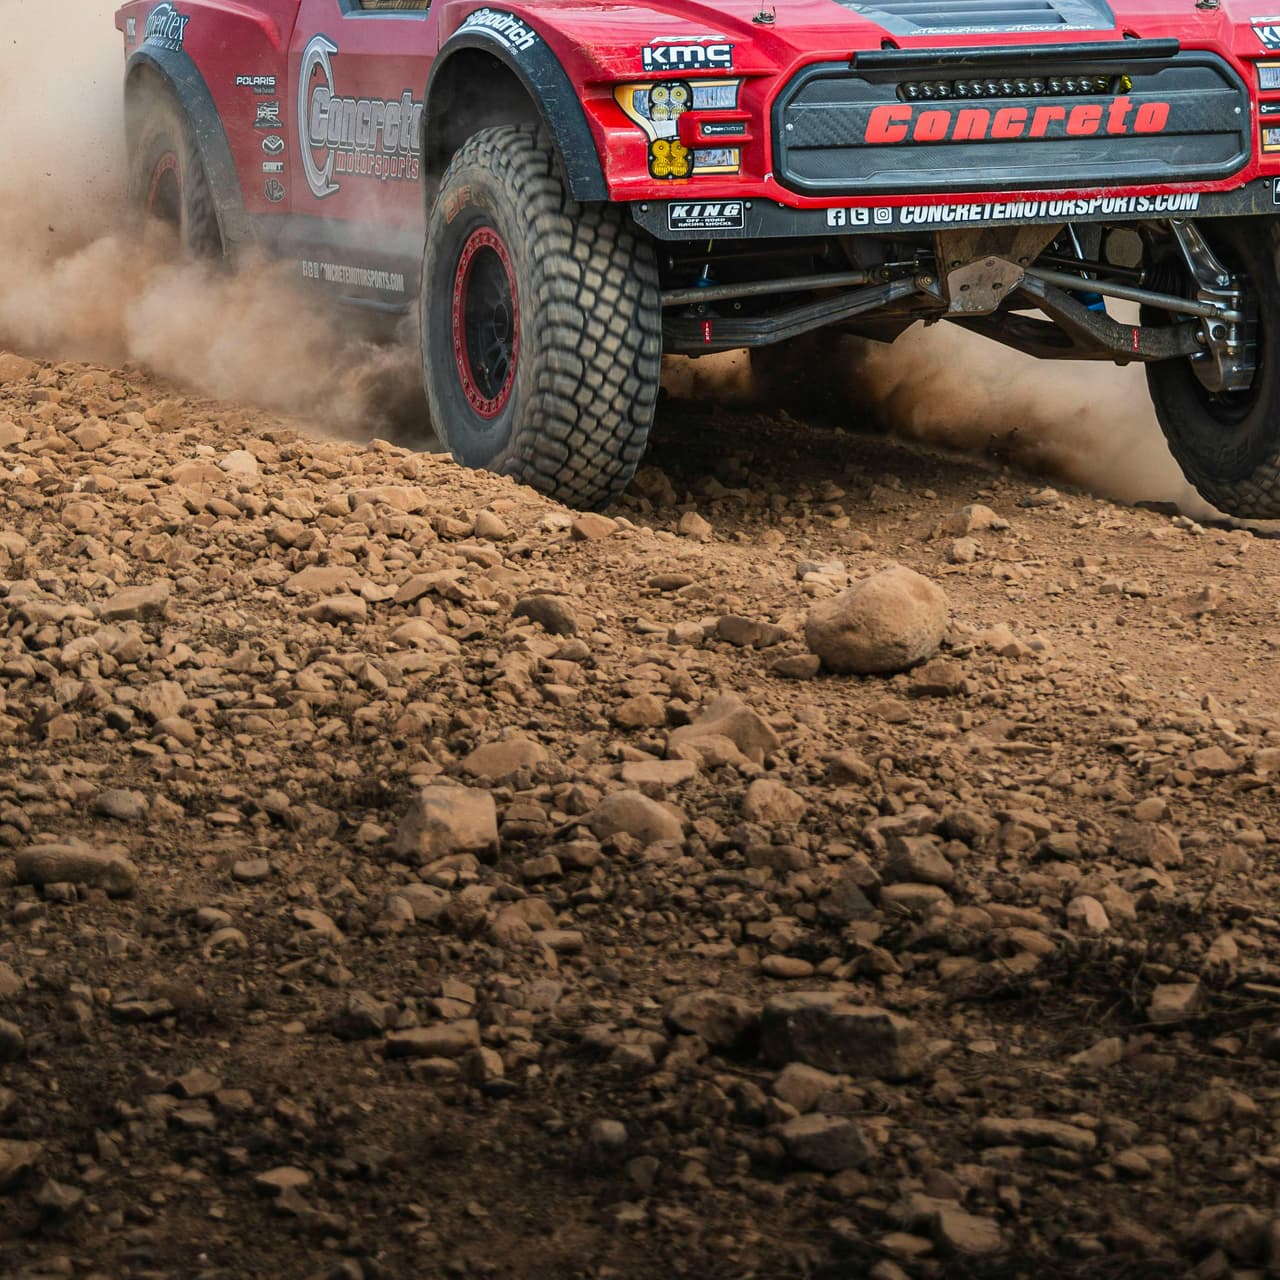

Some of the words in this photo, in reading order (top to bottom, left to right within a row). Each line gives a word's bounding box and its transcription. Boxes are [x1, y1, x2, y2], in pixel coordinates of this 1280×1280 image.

[236, 77, 276, 85] POLARIS
[864, 96, 1170, 144] Concreto
[336, 151, 419, 180] motorsports
[672, 204, 741, 217] KING
[899, 193, 1201, 225] CONCRETEMOTORSPORTS.COM
